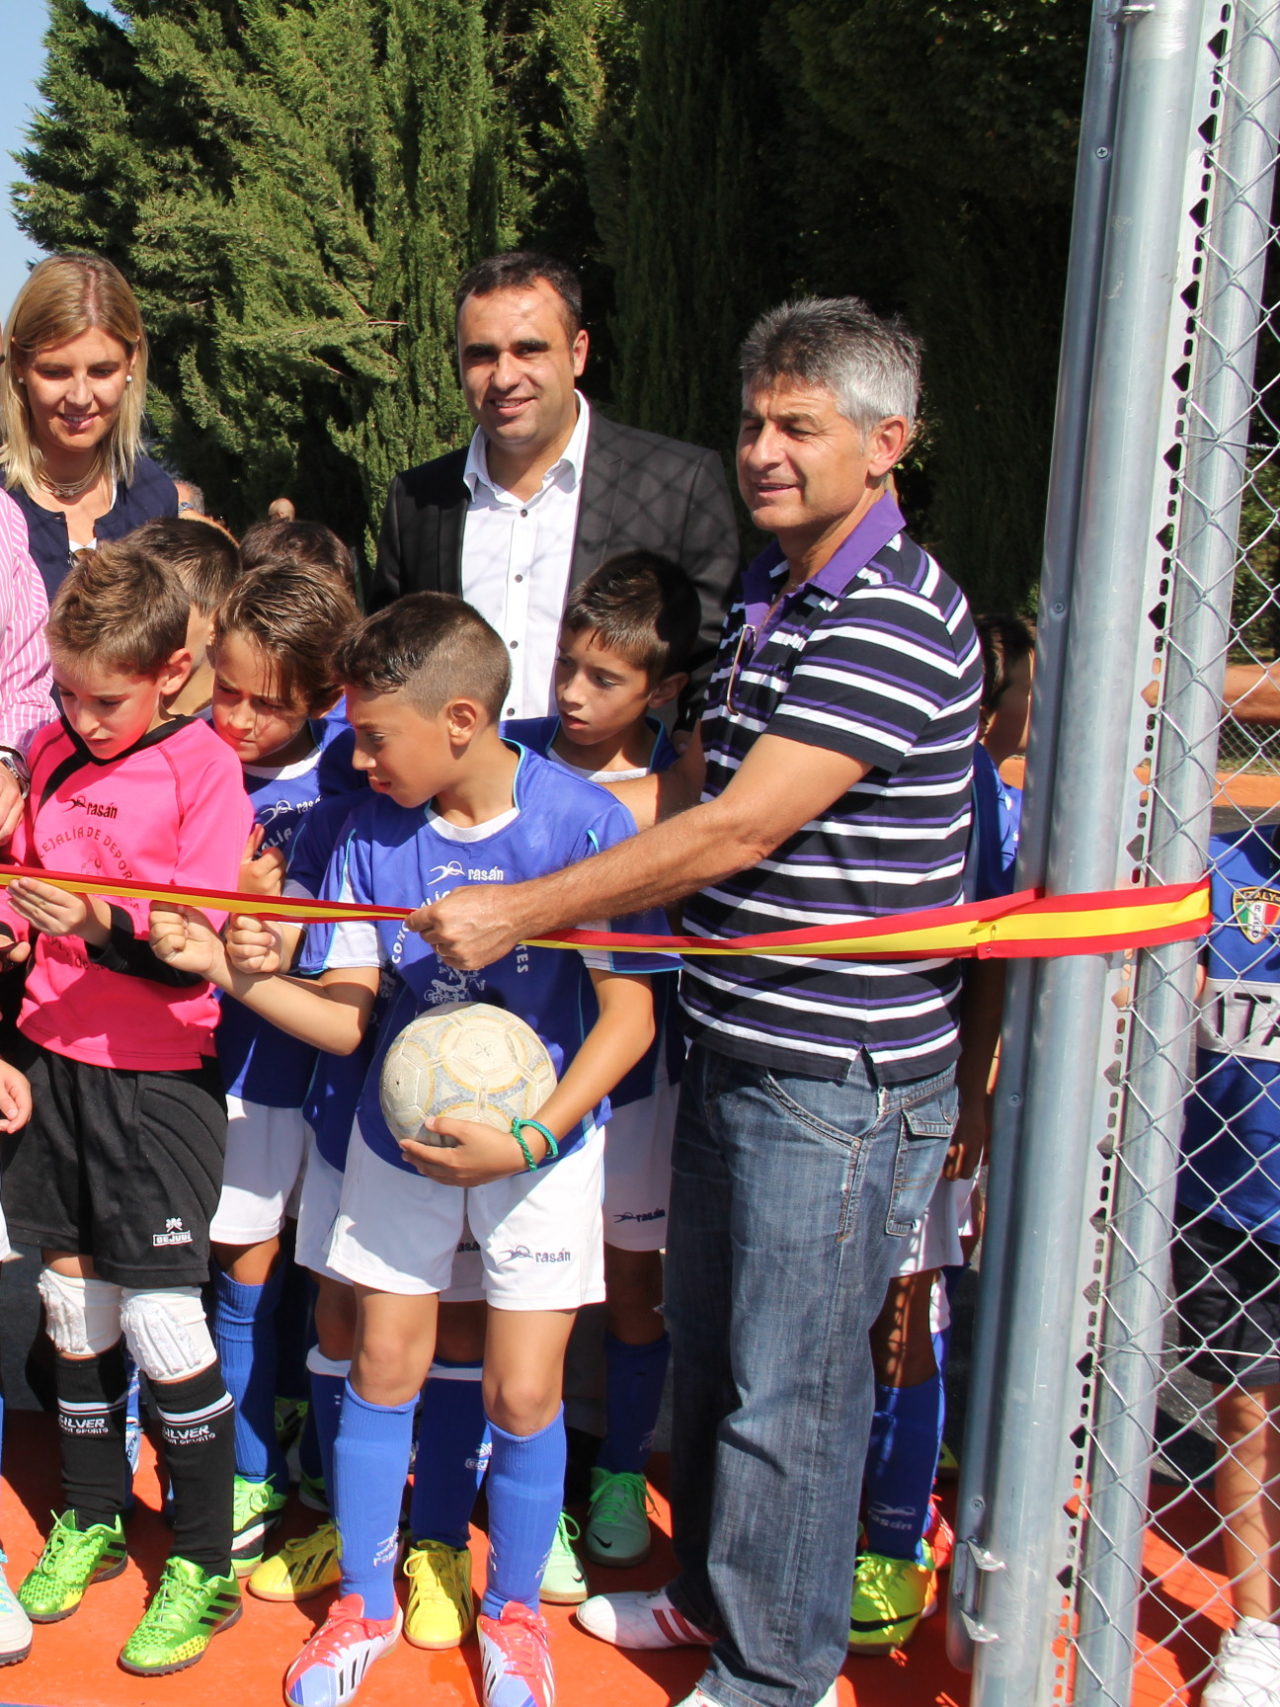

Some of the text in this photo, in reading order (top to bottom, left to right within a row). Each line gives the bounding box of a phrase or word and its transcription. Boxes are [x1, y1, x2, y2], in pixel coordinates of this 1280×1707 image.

[87, 802, 118, 819] rasán
[87, 827, 101, 840] DE
[468, 866, 504, 881] rasán
[535, 1247, 570, 1263] rasán
